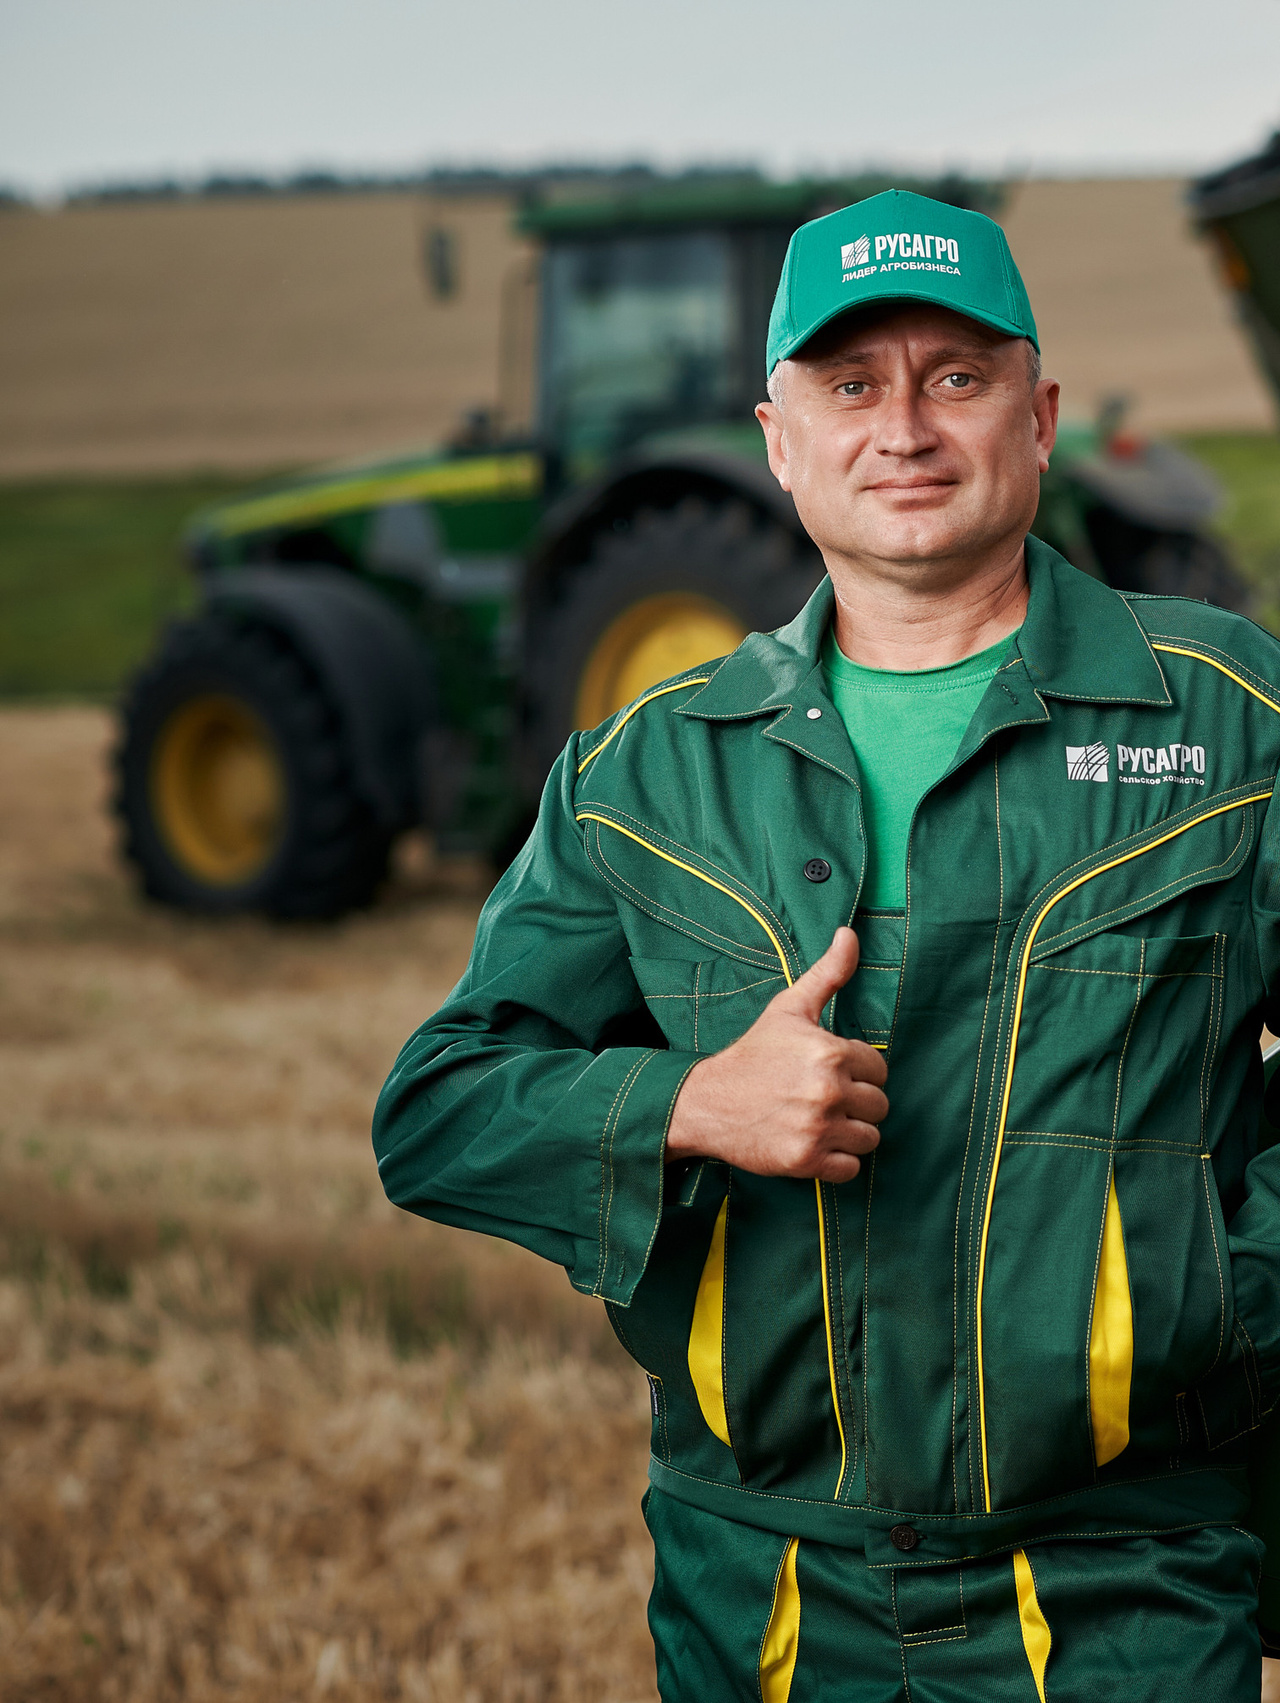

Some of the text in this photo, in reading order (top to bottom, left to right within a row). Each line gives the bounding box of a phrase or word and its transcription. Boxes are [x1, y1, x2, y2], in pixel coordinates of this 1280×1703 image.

[874, 233, 959, 263] РУСАГРО
[841, 262, 962, 283] ЛИДЕР АГРОБИЗНЕСА
[1116, 743, 1206, 774] РУСАГРО
[1118, 775, 1161, 785] сельское
